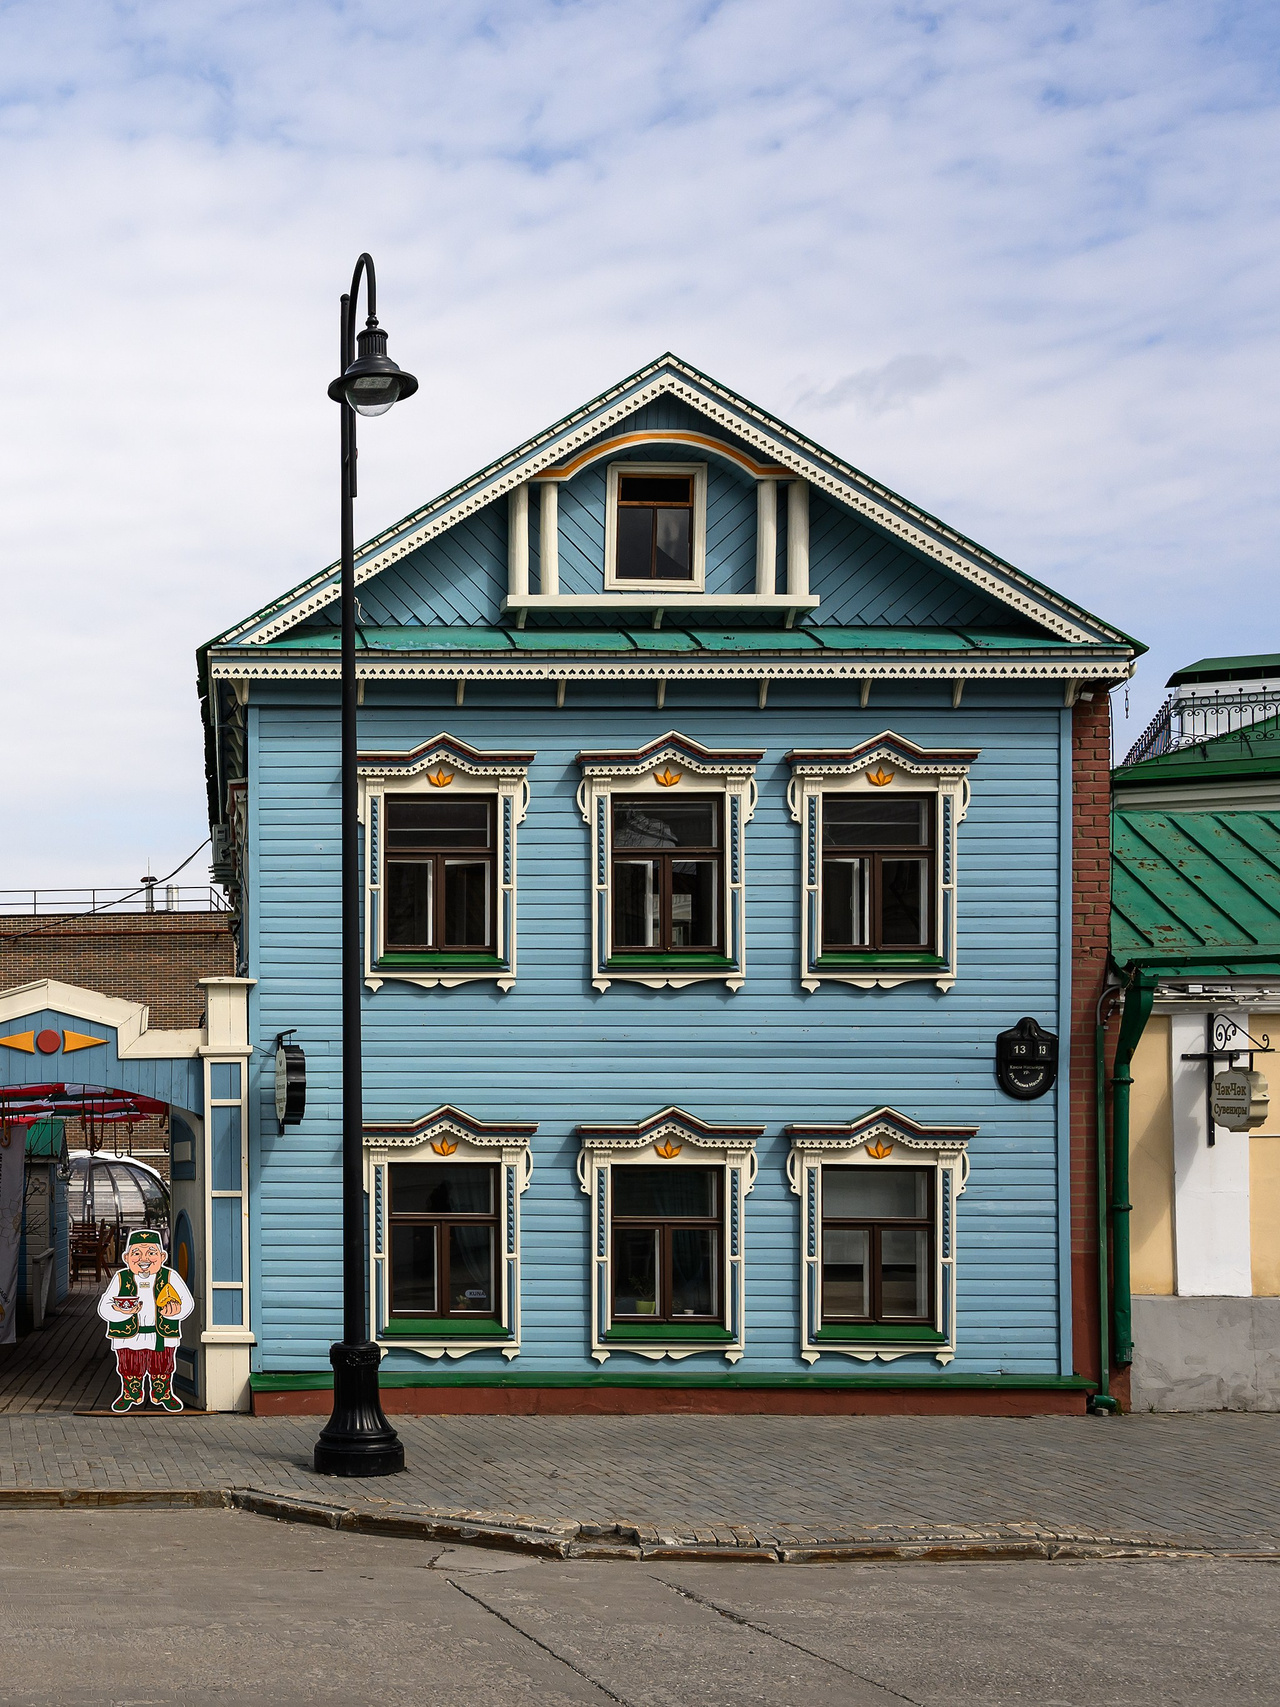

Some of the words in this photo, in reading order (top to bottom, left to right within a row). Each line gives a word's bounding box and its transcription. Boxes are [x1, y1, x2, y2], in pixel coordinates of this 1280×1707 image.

[1014, 1045, 1026, 1054] 13
[1039, 1045, 1046, 1054] 13
[1214, 1103, 1247, 1117] Сувениры
